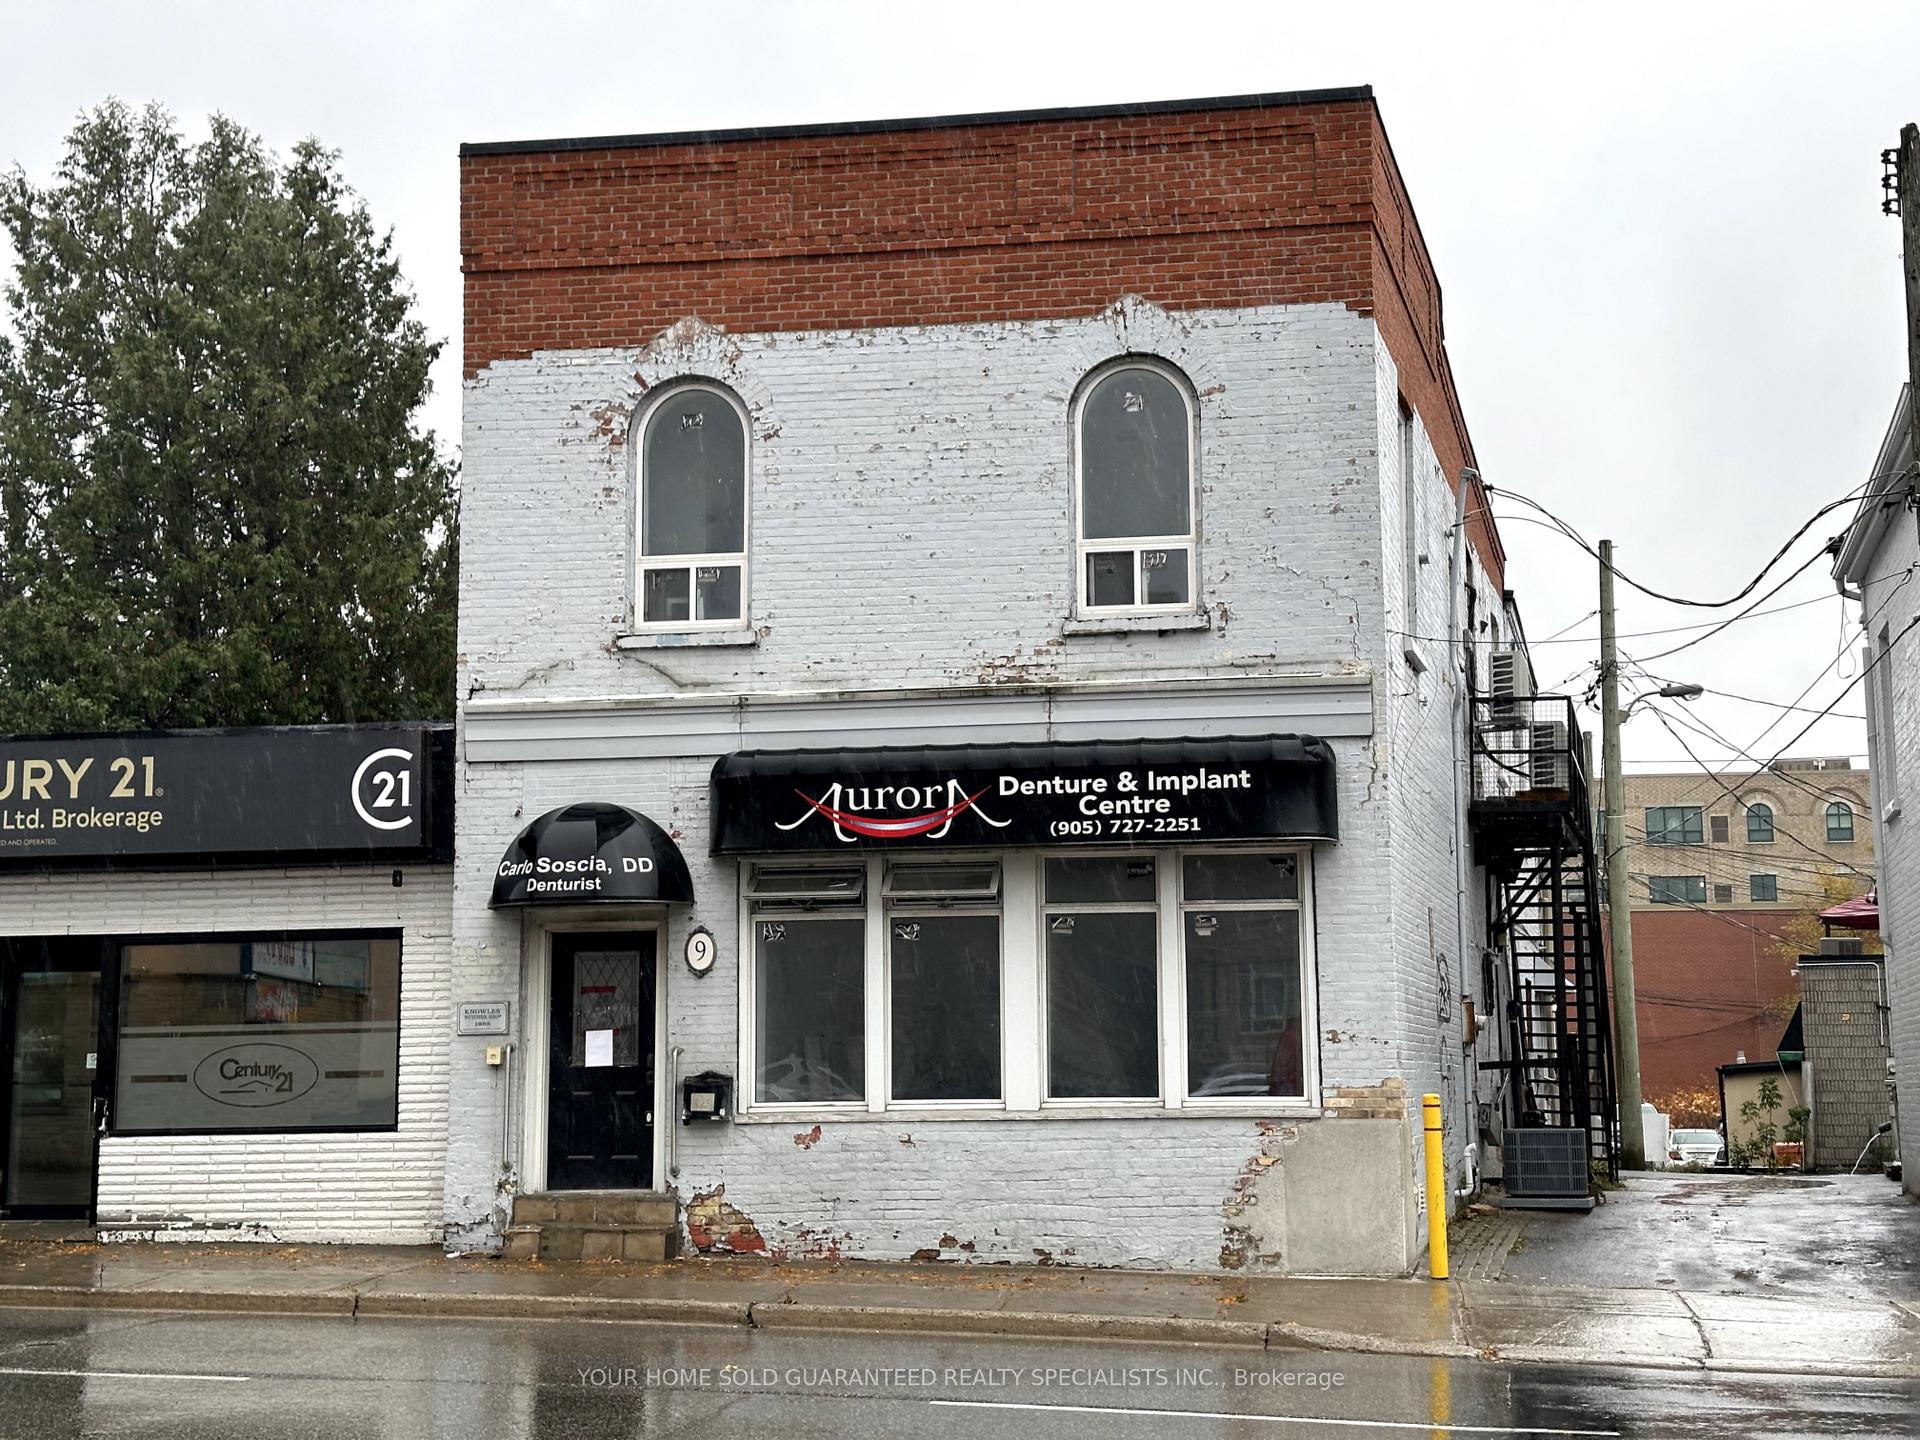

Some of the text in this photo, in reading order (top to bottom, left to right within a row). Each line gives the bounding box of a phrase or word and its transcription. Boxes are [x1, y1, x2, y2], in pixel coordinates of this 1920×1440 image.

[999, 768, 1251, 795] Denture & Implant
[1079, 795, 1171, 816] Centre
[3, 806, 163, 832] Ltd. Brokerage
[1050, 818, 1201, 836] (905) 727-2251
[499, 855, 653, 876] Carlo Soscia, DD
[527, 876, 602, 892] Denturist
[695, 940, 706, 961] 9
[220, 1058, 282, 1080] Century
[275, 1071, 294, 1092] 21
